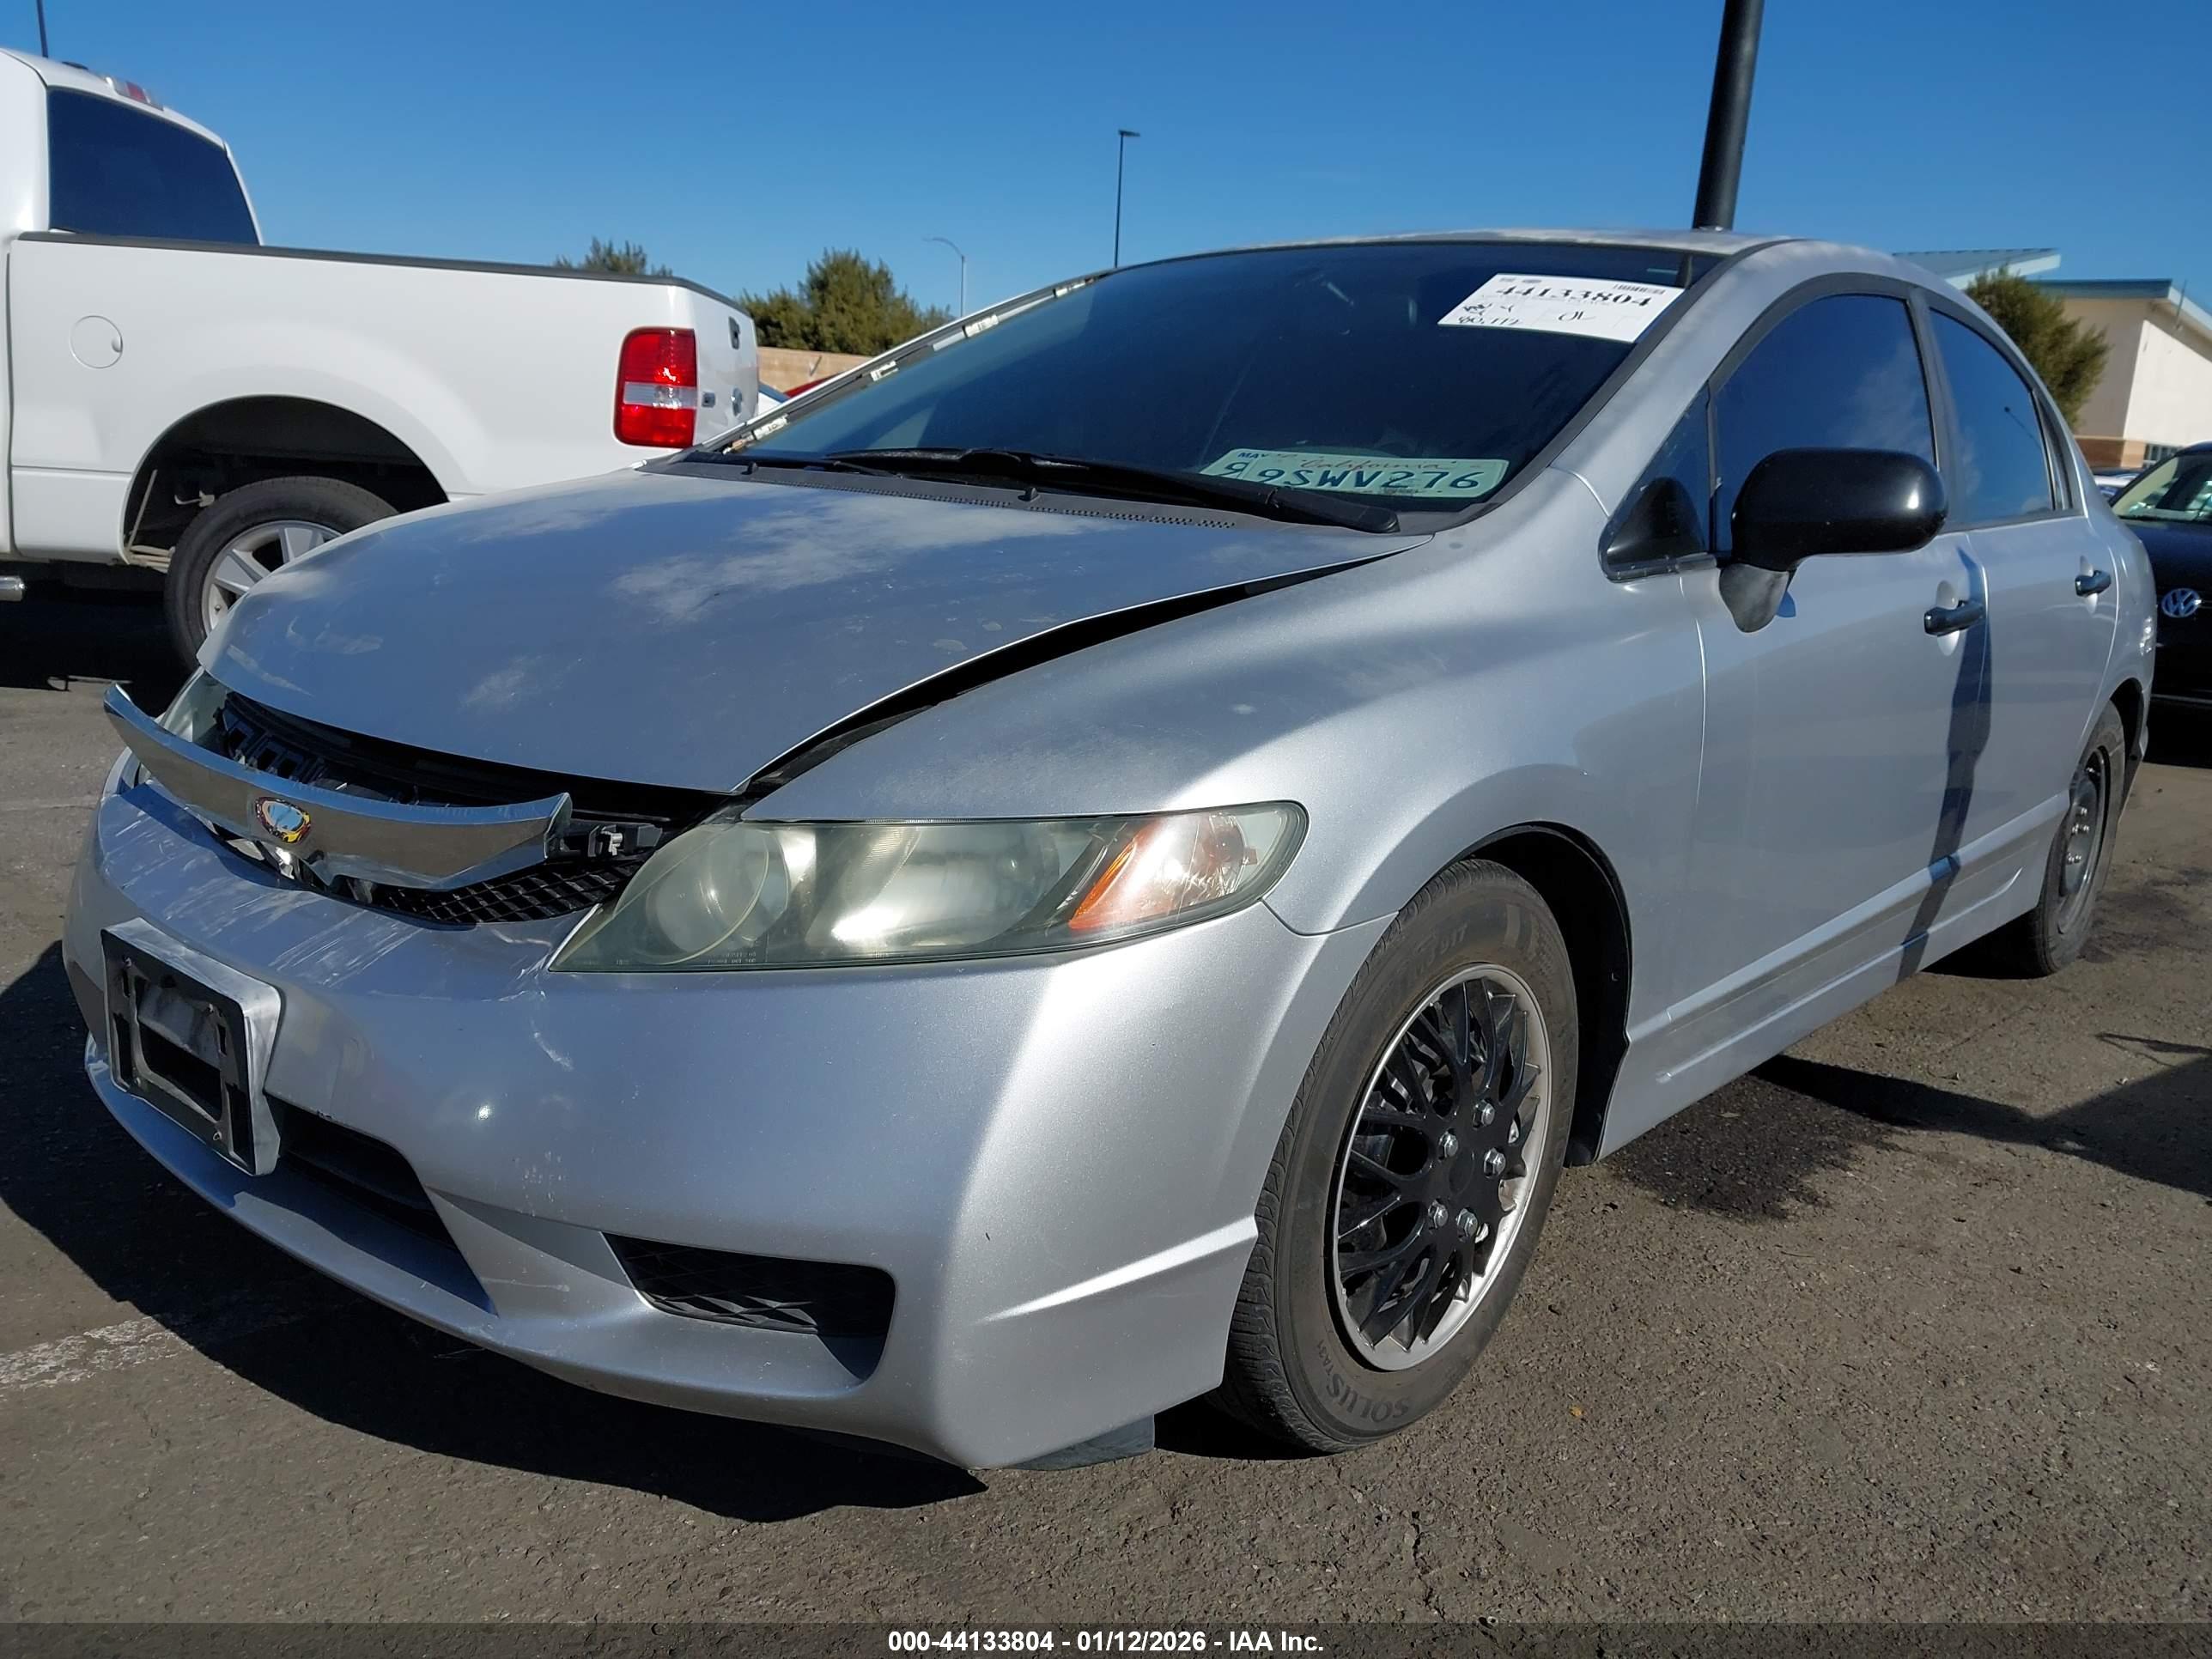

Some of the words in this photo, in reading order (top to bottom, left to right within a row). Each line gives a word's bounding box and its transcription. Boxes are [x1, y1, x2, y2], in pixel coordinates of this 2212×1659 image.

[1496, 286, 1652, 307] 44133804
[1257, 469, 1485, 489] 9SWV276
[1327, 1374, 1409, 1422] SOLUS
